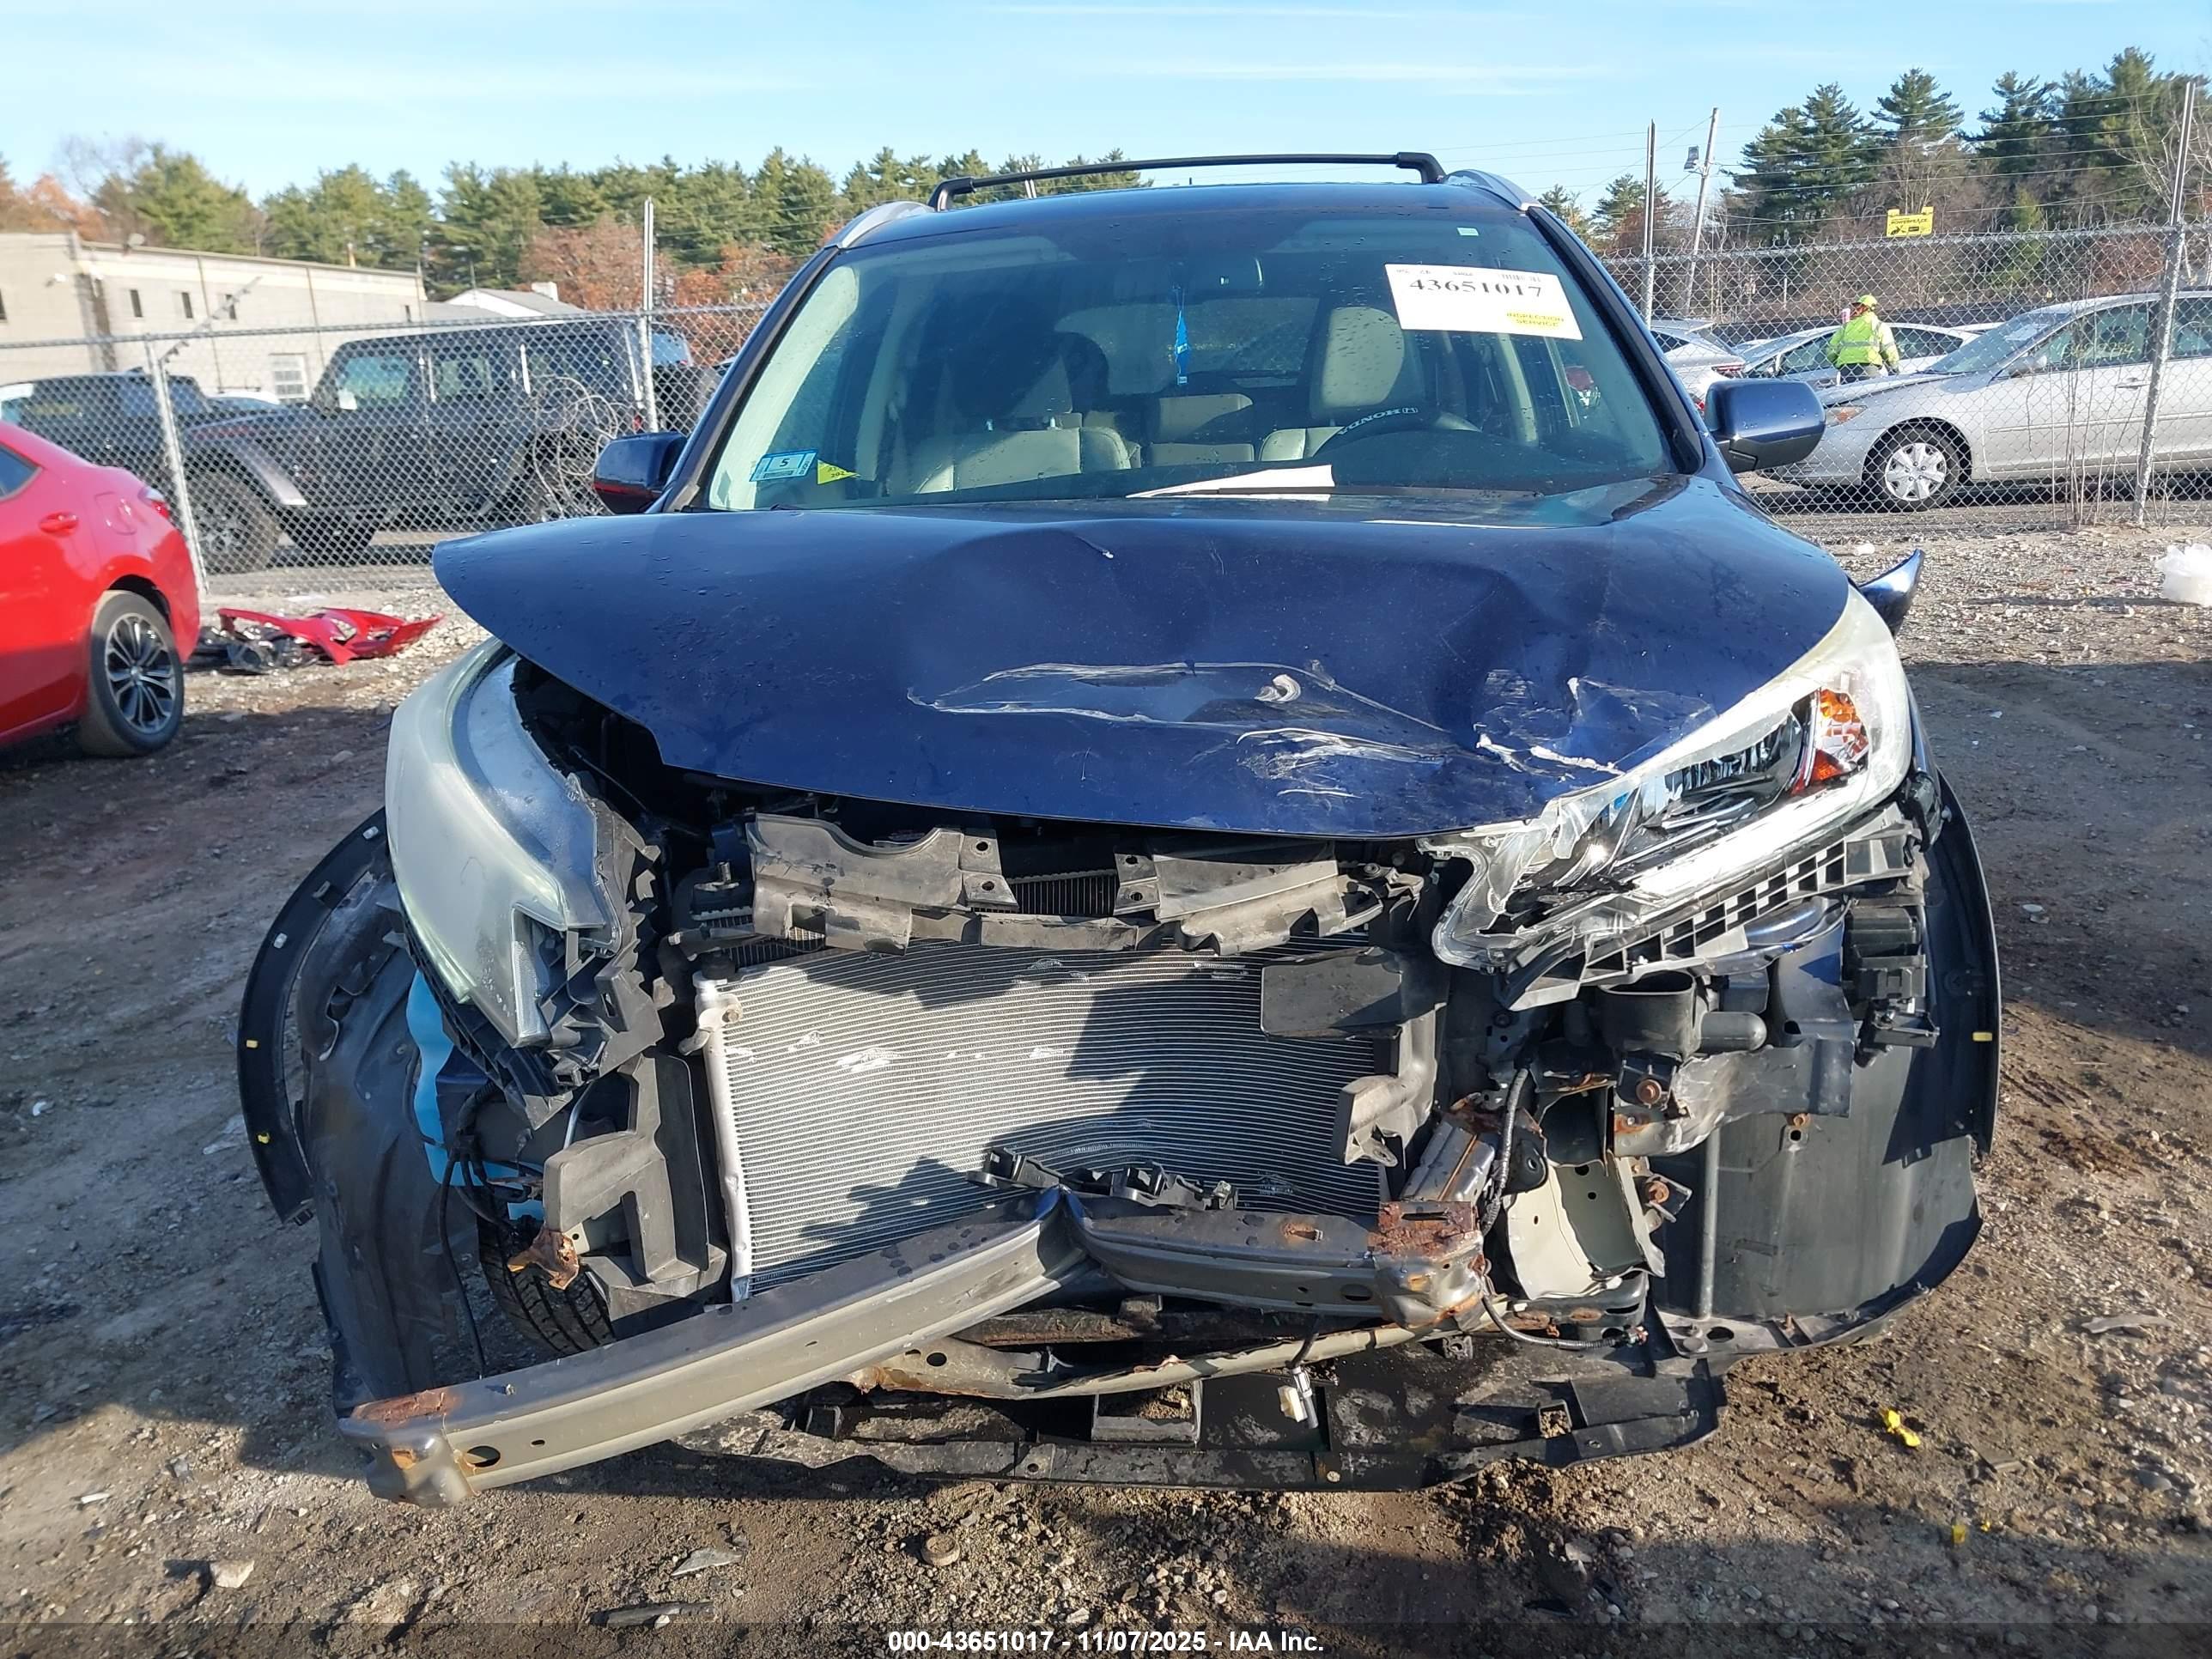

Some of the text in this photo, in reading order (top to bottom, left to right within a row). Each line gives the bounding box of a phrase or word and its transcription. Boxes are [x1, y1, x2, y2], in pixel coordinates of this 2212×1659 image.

[1409, 278, 1542, 297] 43651017
[1337, 408, 1401, 435] HONDA
[779, 458, 790, 467] 5
